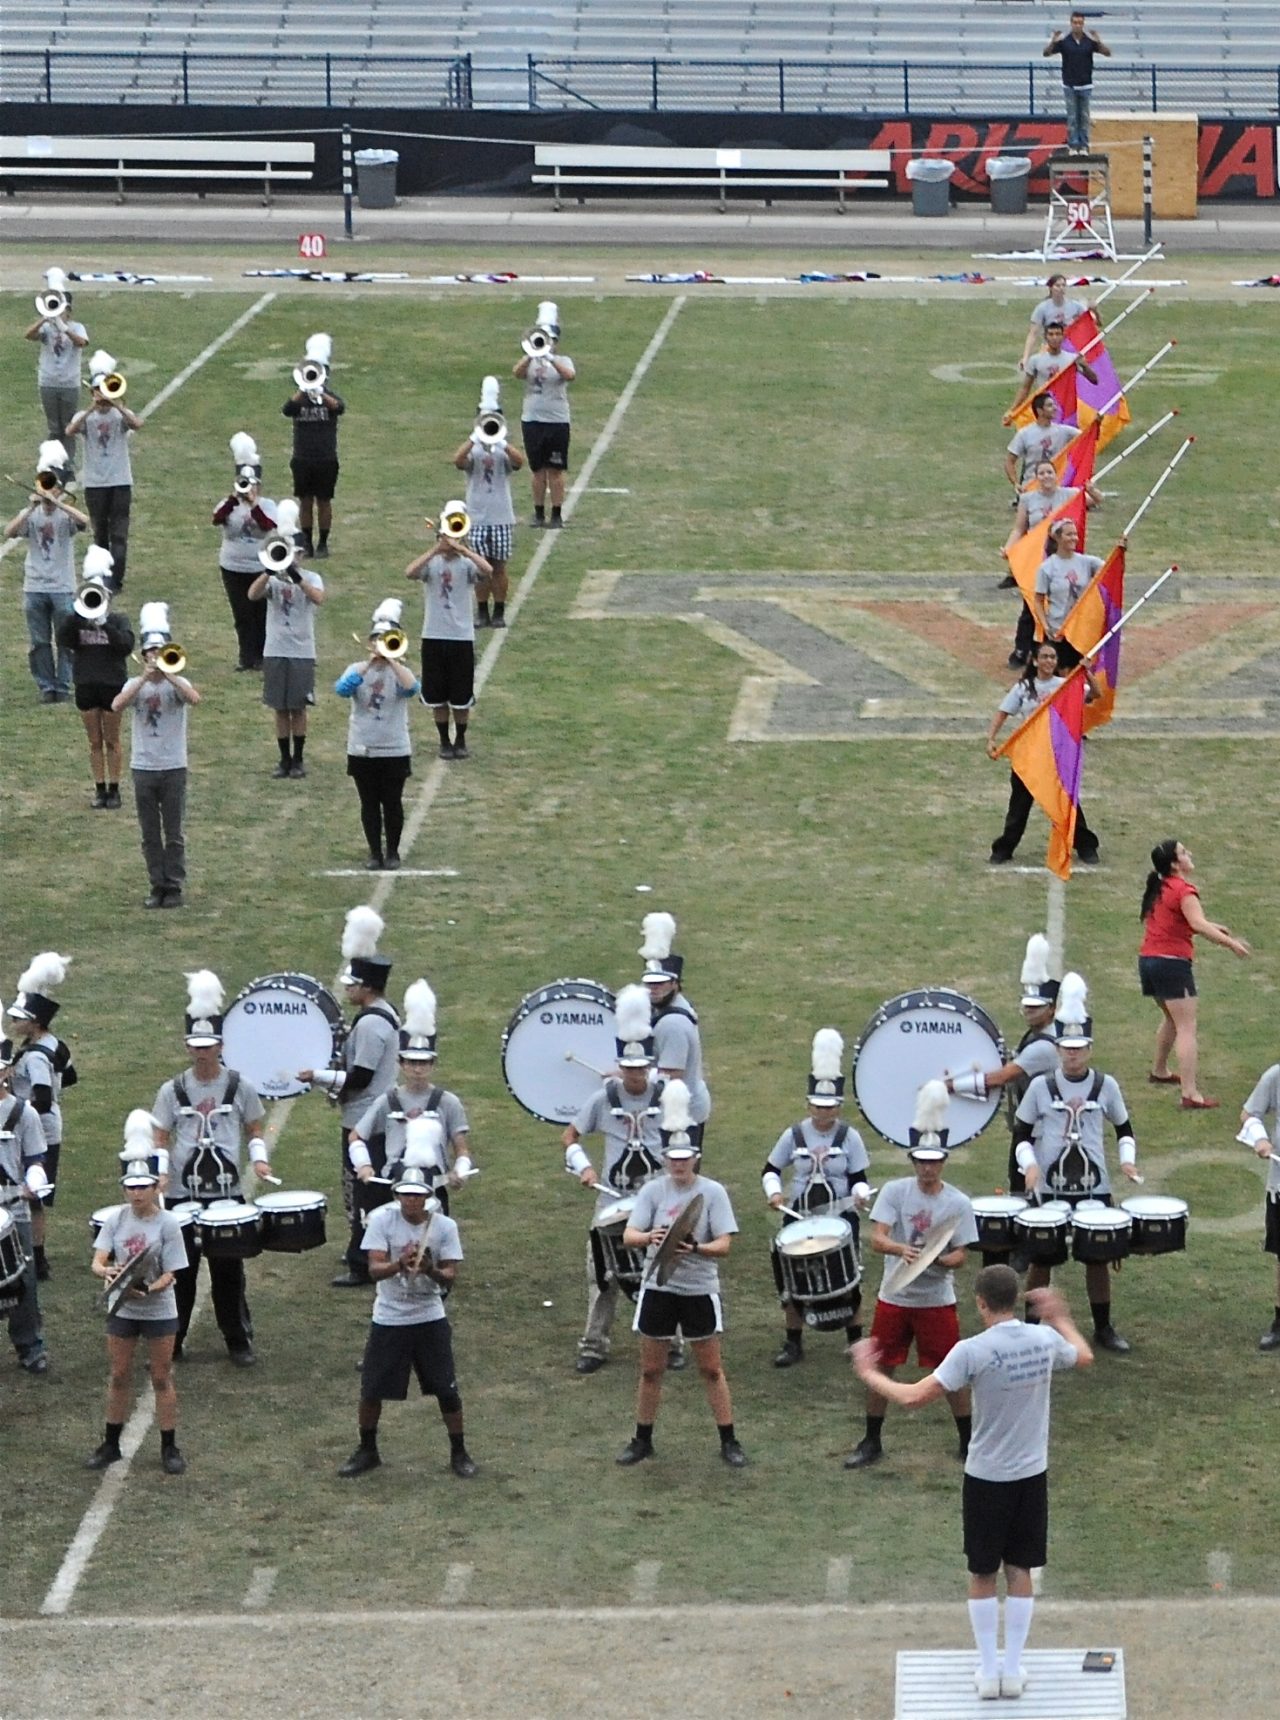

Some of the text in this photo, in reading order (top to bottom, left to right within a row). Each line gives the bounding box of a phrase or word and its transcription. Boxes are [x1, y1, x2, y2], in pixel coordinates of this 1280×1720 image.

[842, 122, 1274, 197] ARIZA
[1068, 203, 1089, 222] 50
[301, 236, 323, 256] 40
[259, 1003, 307, 1015] YAMAHA
[555, 1013, 604, 1025] YAMAHA
[915, 1021, 962, 1034] YAMAHA
